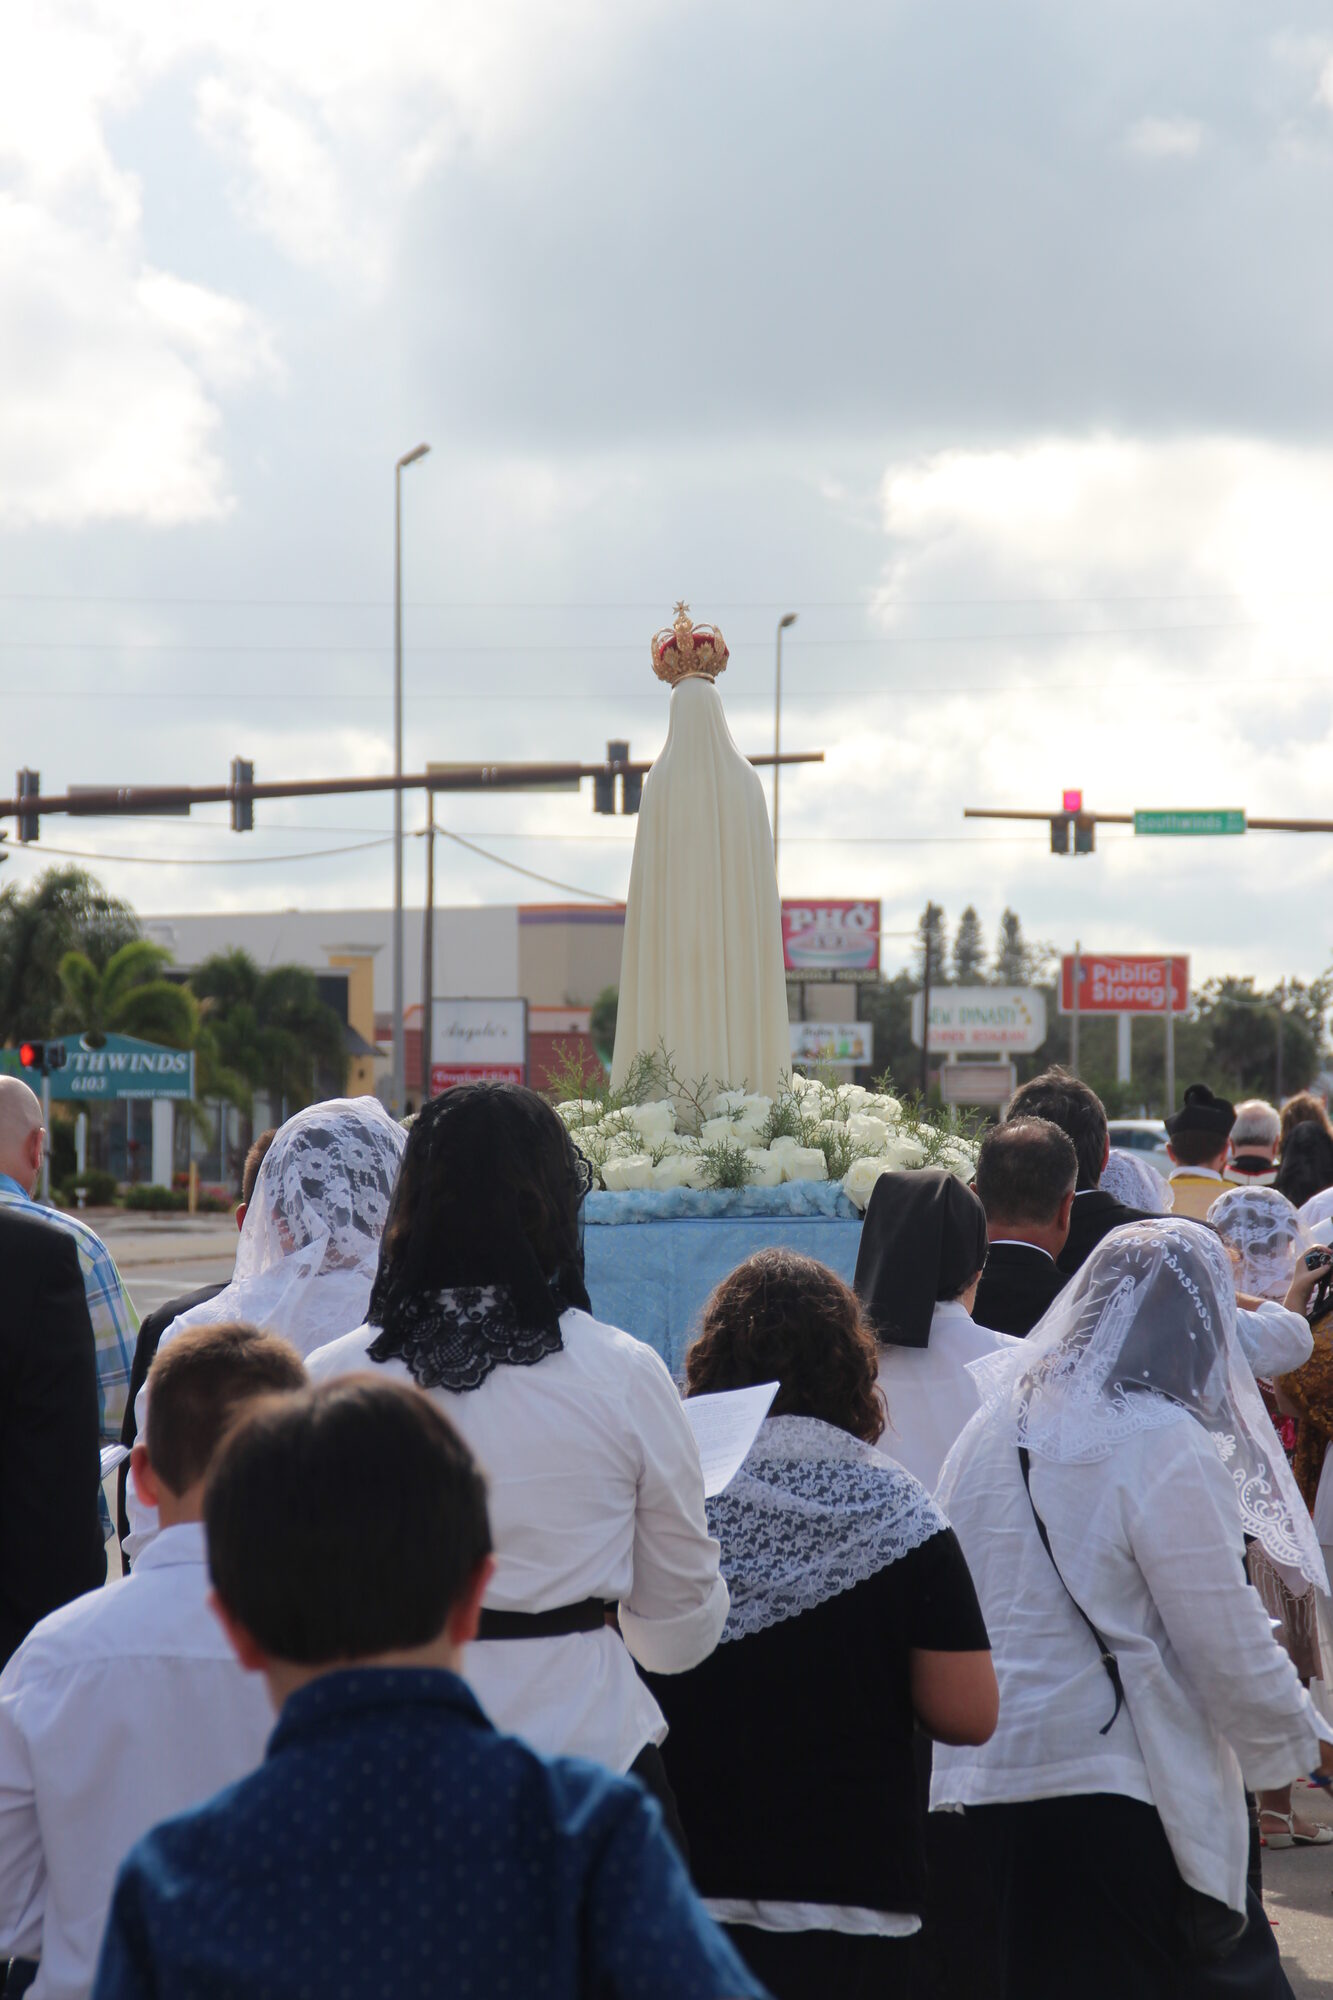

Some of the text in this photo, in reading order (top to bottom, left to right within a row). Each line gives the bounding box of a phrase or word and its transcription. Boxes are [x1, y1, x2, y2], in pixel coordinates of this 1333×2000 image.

[1092, 963, 1161, 982] Public
[959, 1006, 1016, 1024] DYNASTY
[26, 1052, 188, 1073] UTHWINDS
[71, 1076, 107, 1092] 6103
